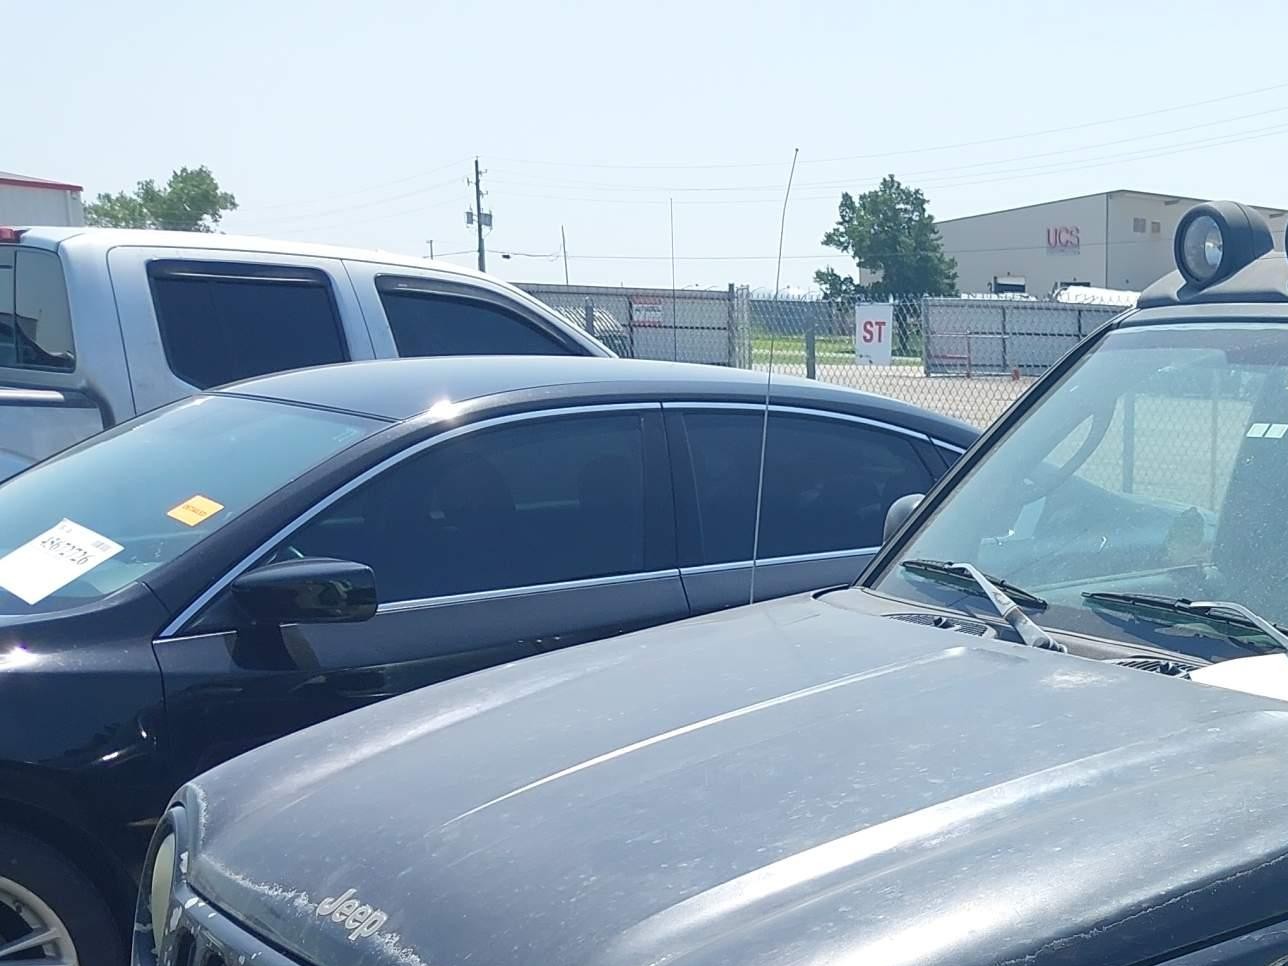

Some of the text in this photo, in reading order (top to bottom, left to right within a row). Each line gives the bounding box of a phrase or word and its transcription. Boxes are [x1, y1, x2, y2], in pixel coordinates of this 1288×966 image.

[1047, 226, 1080, 249] UCS
[862, 320, 886, 344] ST
[316, 888, 388, 941] Jeep
